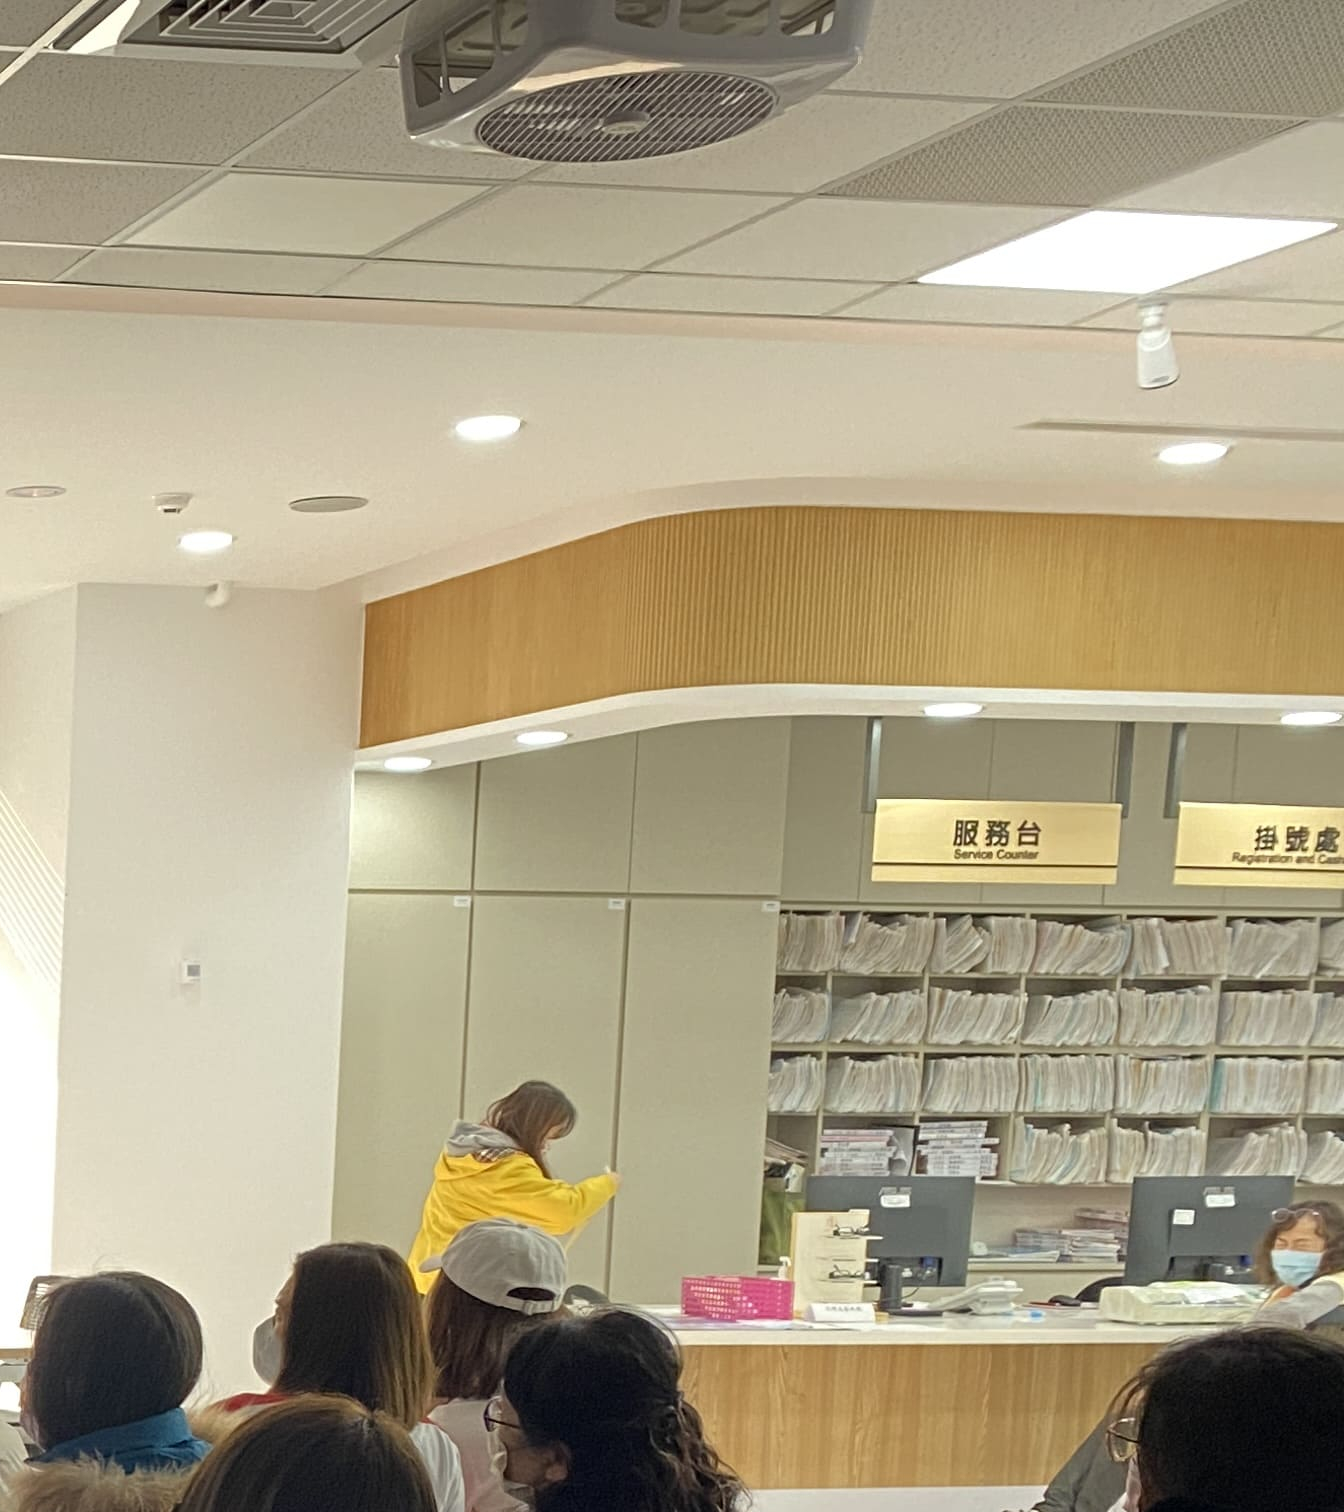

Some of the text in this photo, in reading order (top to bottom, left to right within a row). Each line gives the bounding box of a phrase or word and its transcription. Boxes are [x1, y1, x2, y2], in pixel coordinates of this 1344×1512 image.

[952, 819, 1042, 847] 服務台
[1253, 824, 1341, 853] 掛號處
[953, 848, 1040, 860] Service Counter
